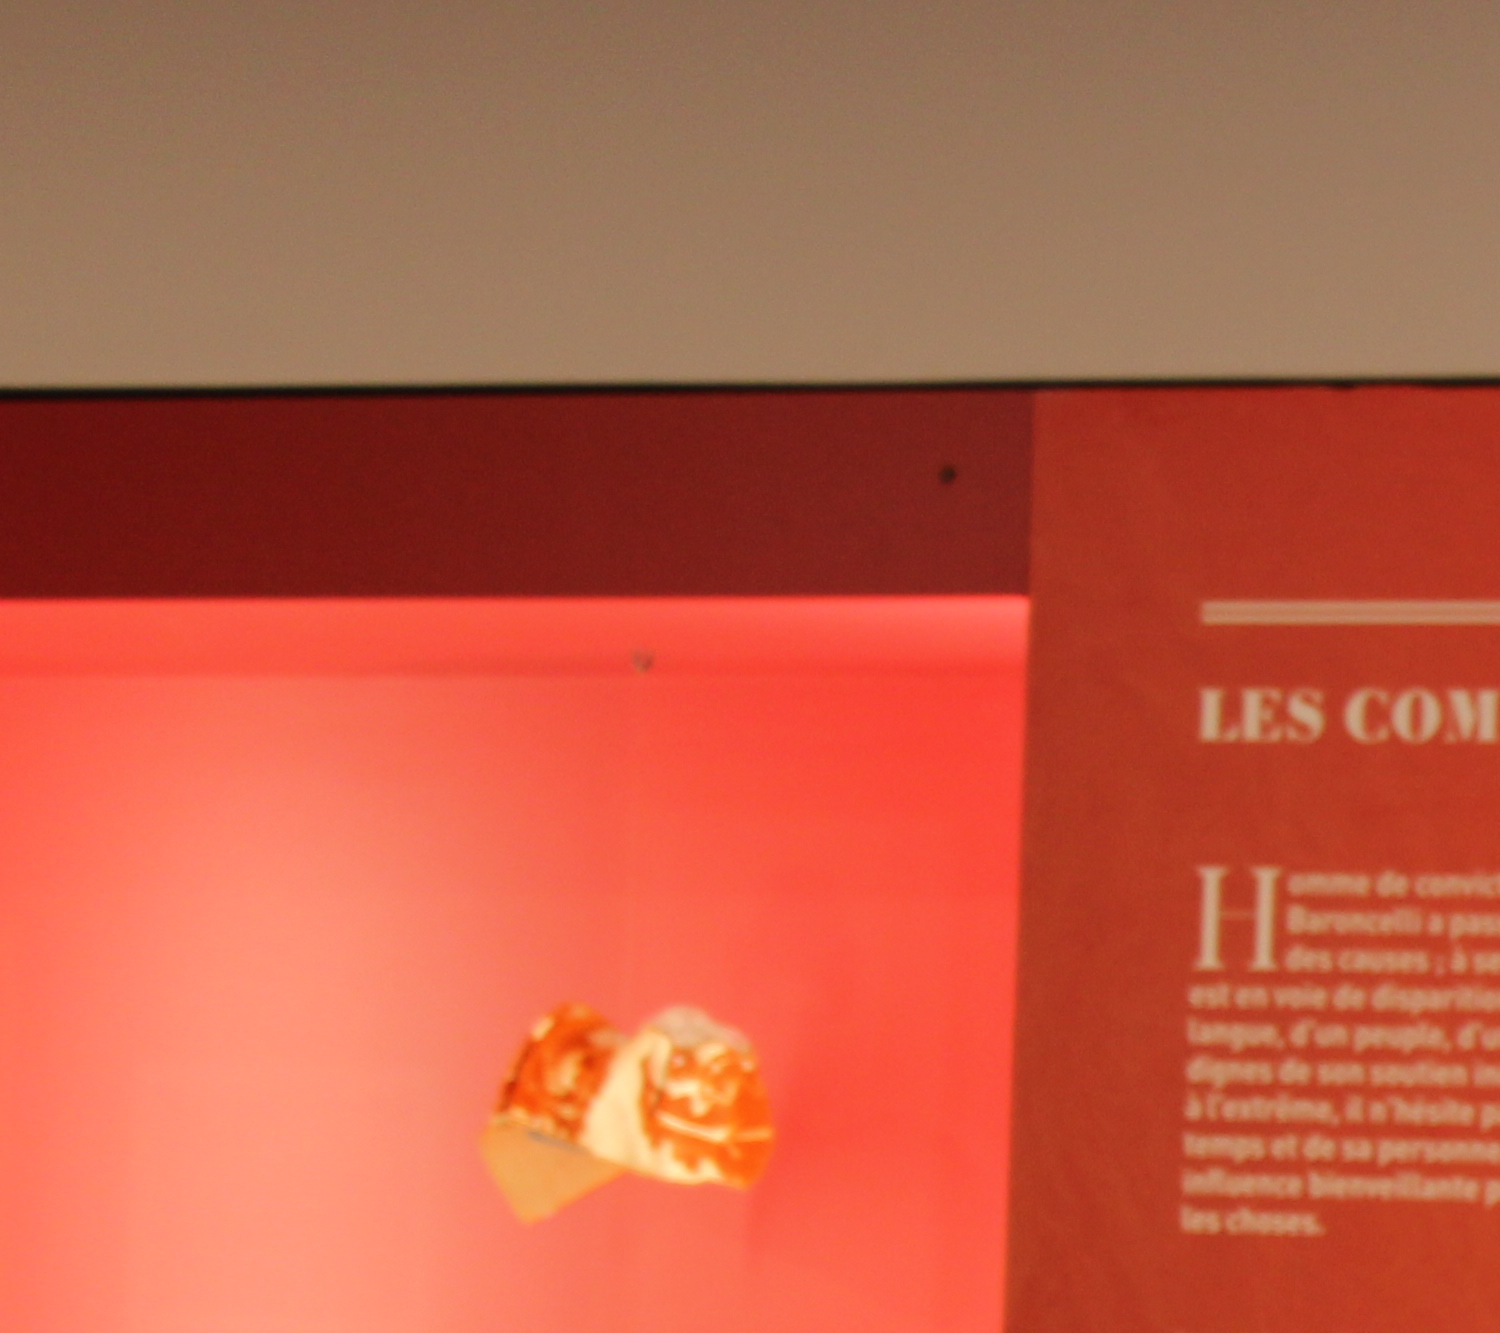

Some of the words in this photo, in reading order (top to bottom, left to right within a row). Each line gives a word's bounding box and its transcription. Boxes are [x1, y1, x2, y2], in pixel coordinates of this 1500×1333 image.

[1197, 689, 1325, 741] LES
[1374, 870, 1409, 896] de
[1285, 905, 1424, 934] Baroncelli
[1426, 913, 1446, 934] a
[1283, 945, 1334, 971] des
[1335, 950, 1430, 972] causes
[1449, 945, 1469, 972] à
[1187, 984, 1231, 1008] est
[1233, 986, 1269, 1008] en
[1271, 985, 1328, 1009] voie
[1331, 984, 1367, 1009] de
[1289, 1020, 1348, 1047] d'un
[1184, 1056, 1274, 1088] dignes
[1276, 1058, 1312, 1084] de
[1315, 1063, 1366, 1084] son
[1368, 1062, 1469, 1086] soutien
[1184, 1092, 1204, 1119] à
[1344, 1095, 1364, 1122] il
[1368, 1097, 1475, 1124] n'hésite
[1182, 1133, 1267, 1162] temps
[1268, 1135, 1299, 1159] et
[1301, 1134, 1337, 1160] de
[1339, 1139, 1374, 1160] sa
[1181, 1168, 1303, 1197] influence
[1306, 1172, 1480, 1200] bienveillante
[1182, 1206, 1218, 1233] les
